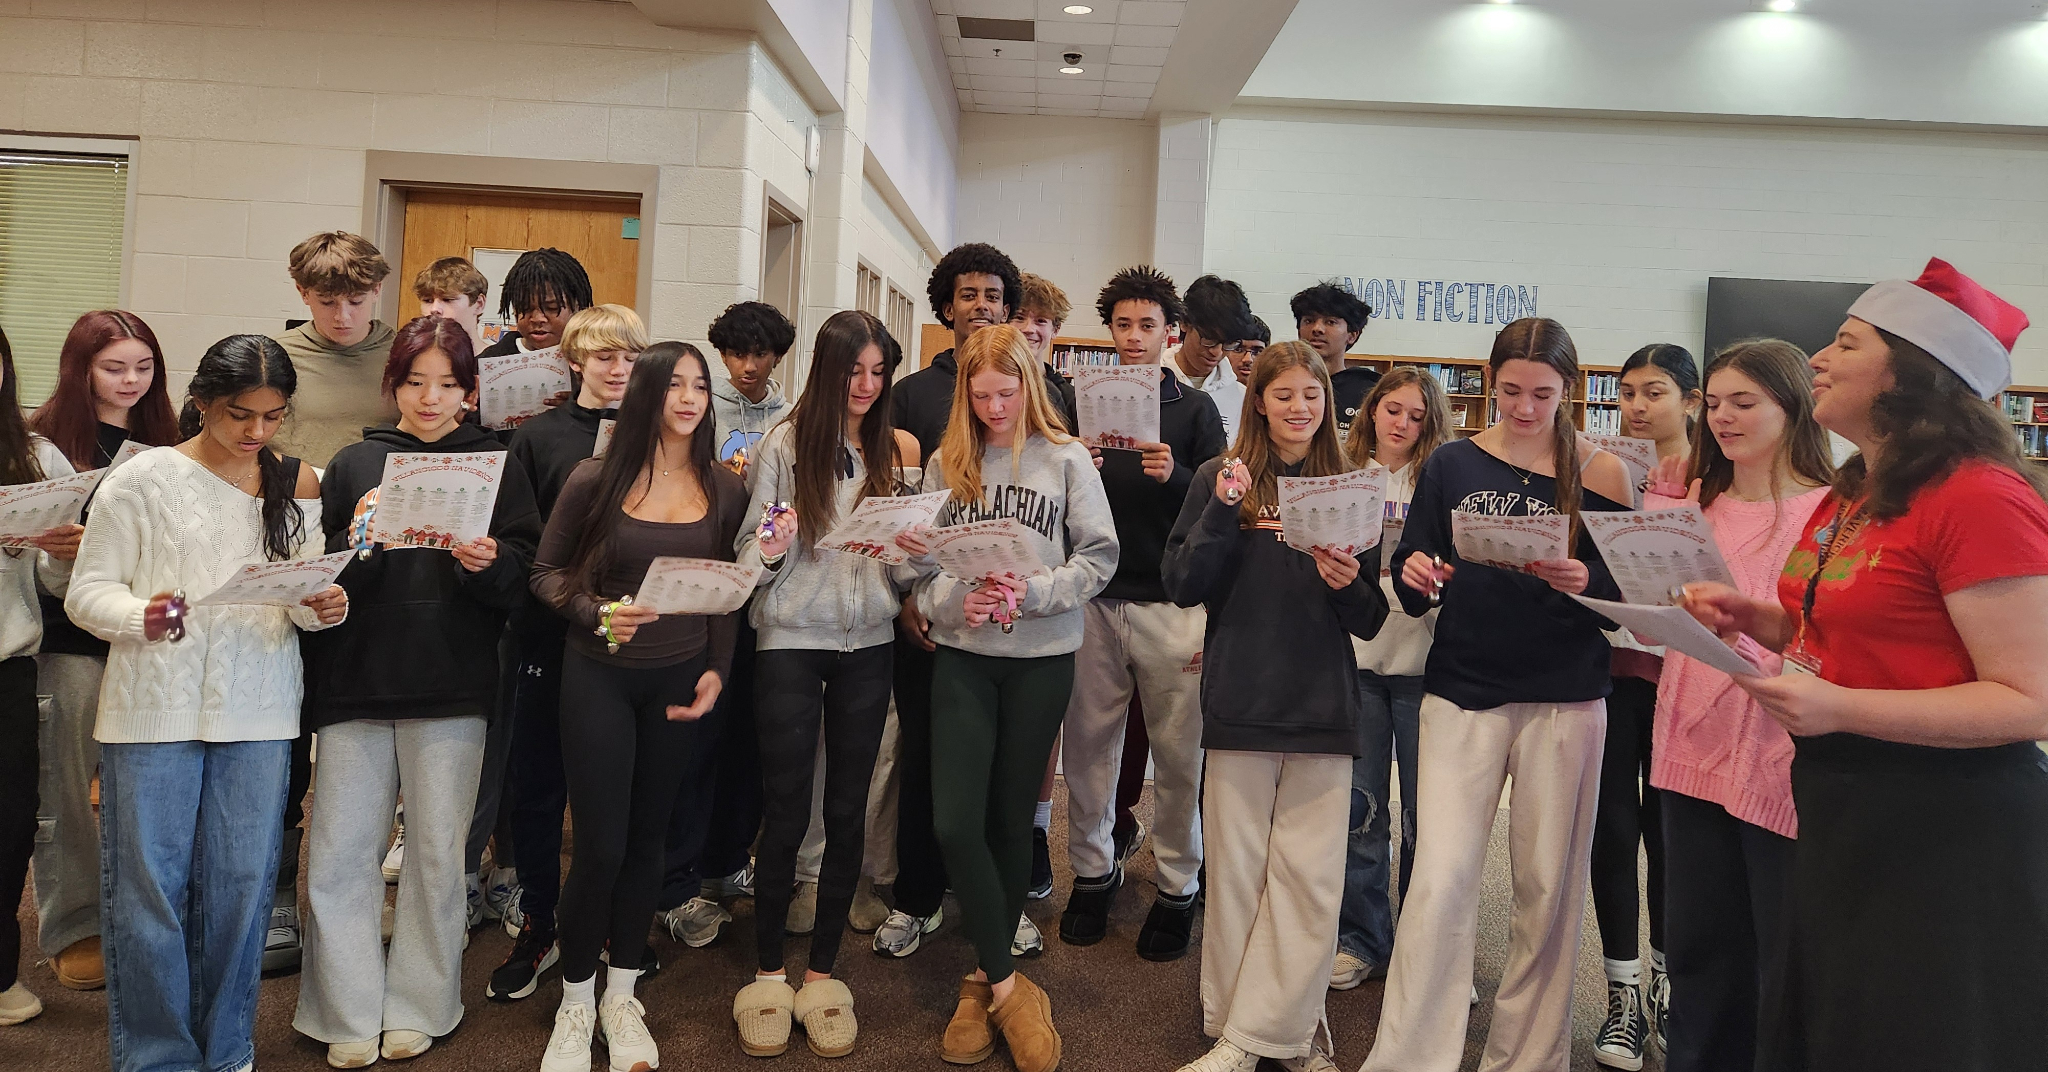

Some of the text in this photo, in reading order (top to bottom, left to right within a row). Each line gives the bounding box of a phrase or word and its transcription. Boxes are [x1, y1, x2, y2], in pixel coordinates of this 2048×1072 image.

[1344, 277, 1539, 325] NON FICTION
[946, 484, 1059, 542] PPALACHIAN
